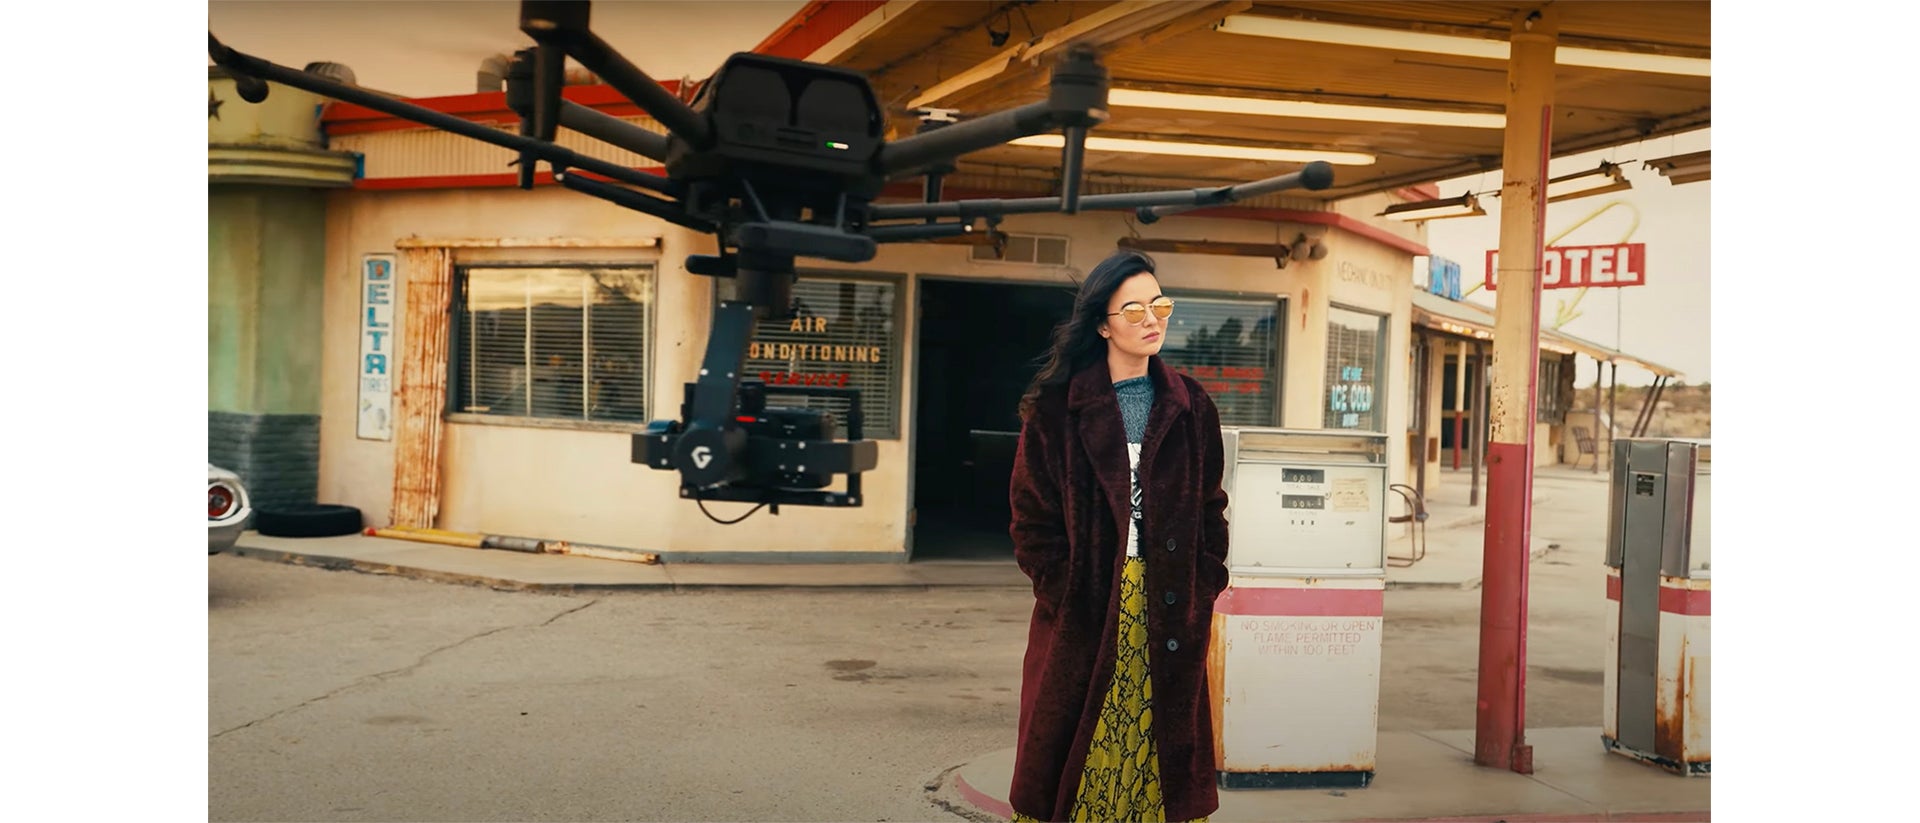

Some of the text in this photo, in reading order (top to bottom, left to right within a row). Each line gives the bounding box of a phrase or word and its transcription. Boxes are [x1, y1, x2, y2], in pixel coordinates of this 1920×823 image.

[1492, 246, 1638, 285] OTEL
[365, 259, 391, 375] DELTA
[790, 316, 828, 333] AIR
[749, 342, 881, 364] ONDITIONING
[758, 371, 850, 387] SERVICE
[1331, 384, 1372, 412] ICE COLD
[1240, 620, 1375, 632] NO SMOKING OR OPEN
[1253, 632, 1361, 644] FLAME PERMITTED
[1258, 644, 1356, 655] WITHIN 100 FEET
